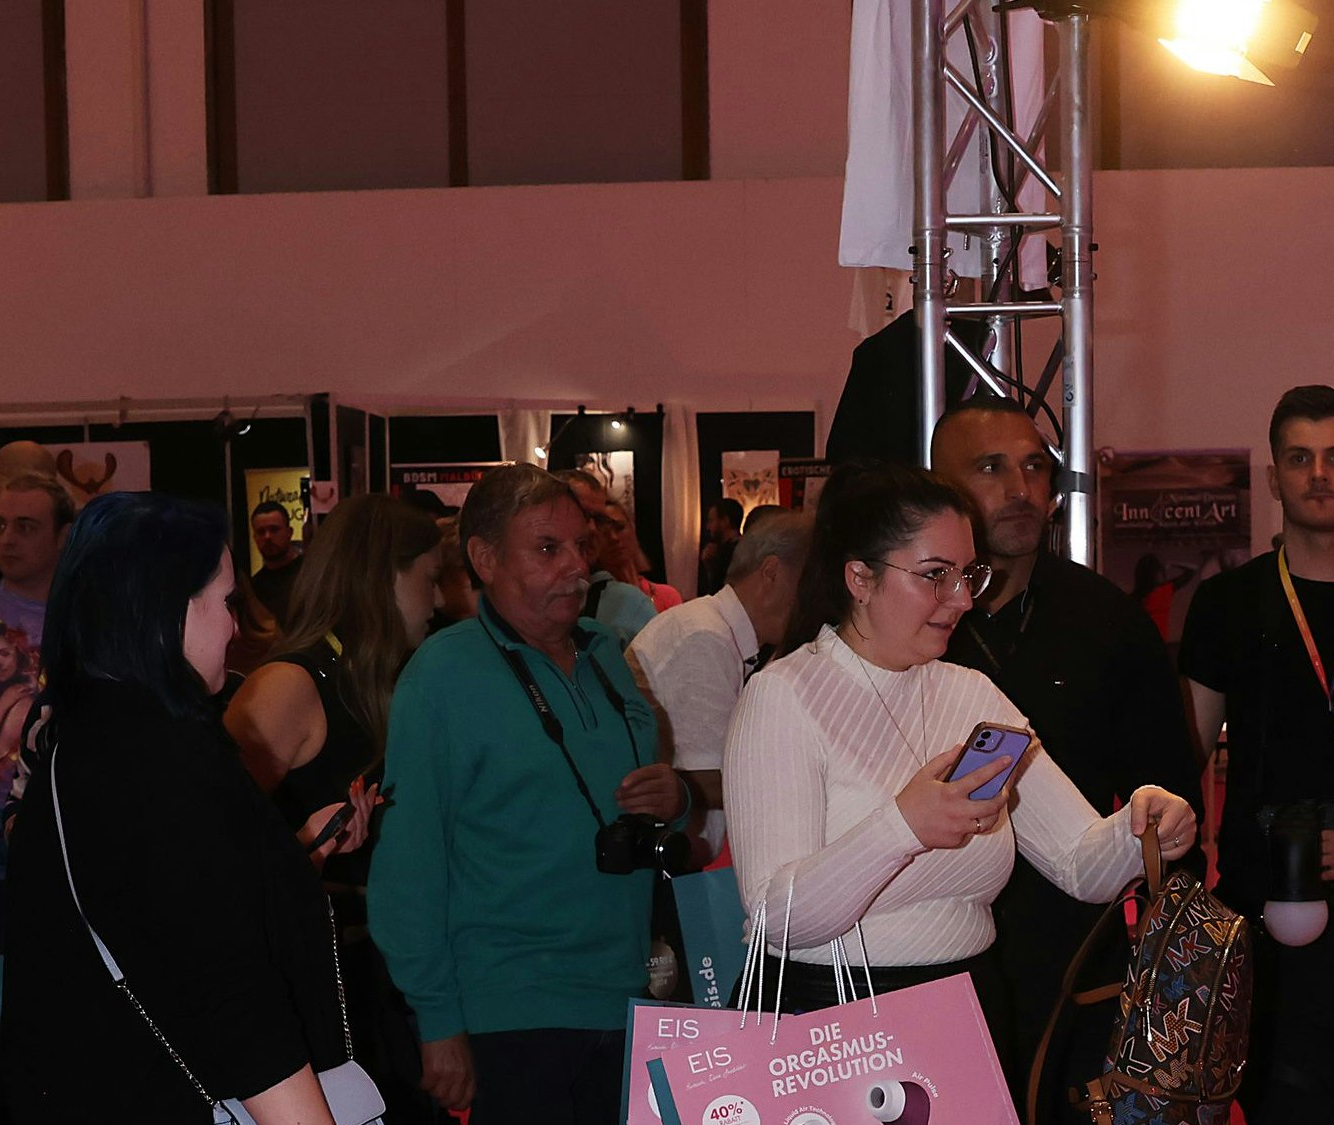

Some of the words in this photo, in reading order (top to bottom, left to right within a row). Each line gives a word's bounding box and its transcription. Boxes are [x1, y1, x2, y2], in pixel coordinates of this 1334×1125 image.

[403, 471, 437, 483] BDSM
[658, 1018, 700, 1039] EIS
[809, 1022, 842, 1045] DIE
[687, 1046, 732, 1075] EIS
[769, 1031, 894, 1077] ORGASMUS-
[771, 1048, 904, 1098] REVOLUTION
